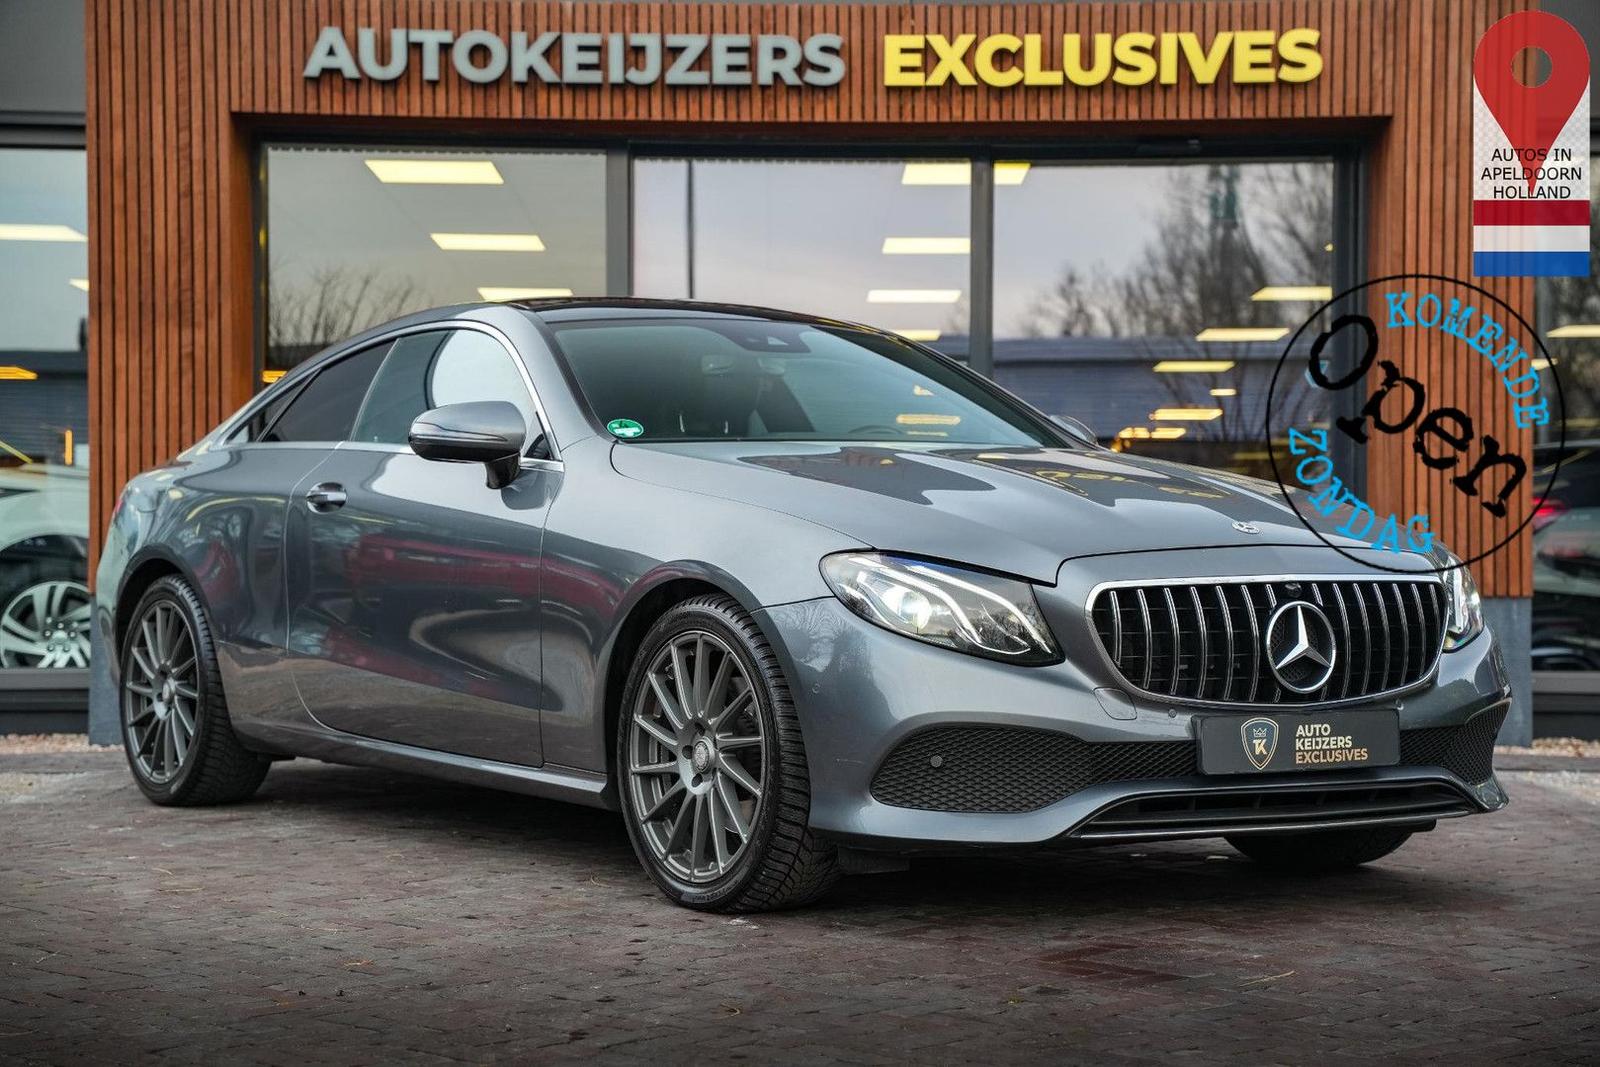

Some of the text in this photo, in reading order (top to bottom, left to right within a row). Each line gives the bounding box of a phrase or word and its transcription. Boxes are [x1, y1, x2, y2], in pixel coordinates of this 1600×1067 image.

[303, 26, 1323, 88] AUTOKEIJZERS EXCLUSIVES
[1296, 724, 1331, 737] AUTO
[1296, 736, 1352, 750] KEIJZERS
[1296, 749, 1368, 764] EXCLUSIVES
